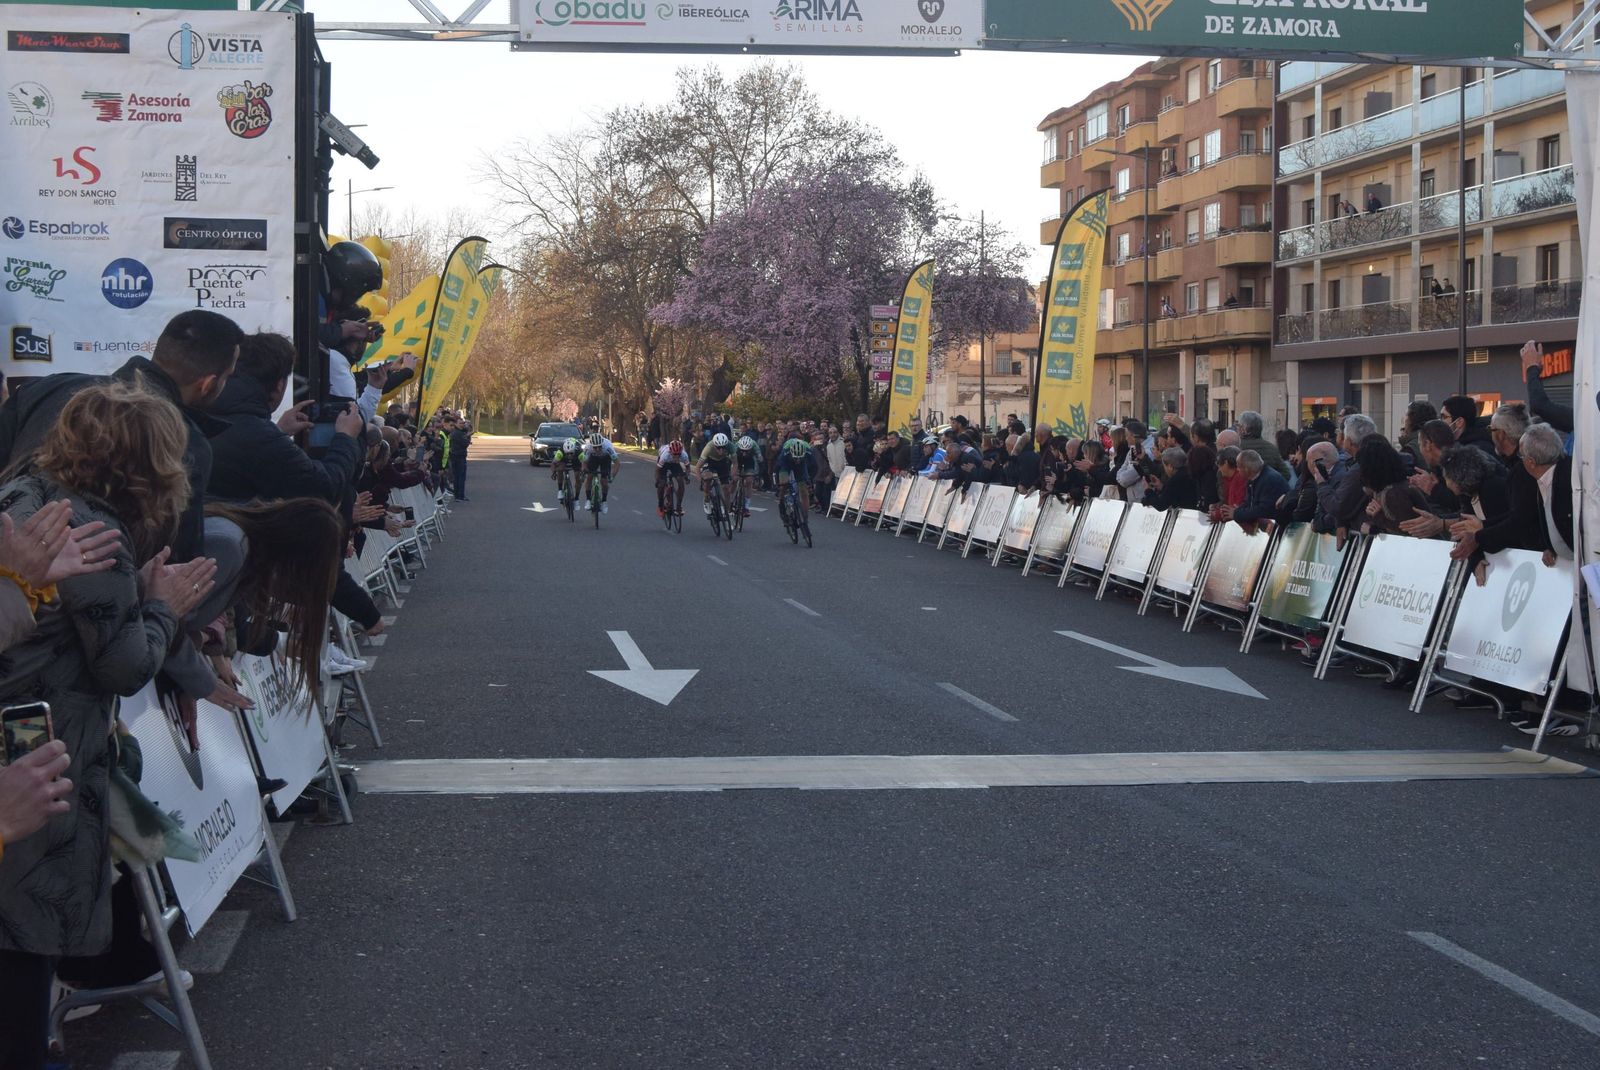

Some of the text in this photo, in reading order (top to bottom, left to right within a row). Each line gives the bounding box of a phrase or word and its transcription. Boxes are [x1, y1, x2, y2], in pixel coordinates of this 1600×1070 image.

[678, 6, 750, 18] IBEREÓLICA
[774, 23, 864, 33] SEMILLAS
[900, 25, 962, 36] MORALEJO
[1204, 15, 1341, 38] DE ZAMORA
[208, 38, 263, 52] VISTA
[208, 52, 264, 64] ALEGRE
[244, 80, 273, 102] bar
[127, 92, 190, 108] Asesoría
[9, 115, 50, 128] Arribes
[127, 109, 182, 122] Zamora
[230, 110, 272, 136] Eras
[39, 189, 55, 197] REY
[80, 190, 117, 198] SANCHO
[29, 219, 110, 236] Espabrok
[176, 228, 264, 240] CENTRO ÓPTICO
[186, 267, 243, 289] Puente
[194, 288, 246, 309] Piedra
[235, 289, 246, 297] de
[15, 335, 50, 355] Susi
[1307, 561, 1336, 583] RURAL
[1374, 583, 1435, 615] IBEREÓLICA
[1476, 640, 1522, 665] MORALEJO
[194, 798, 236, 863] MORALEJO
